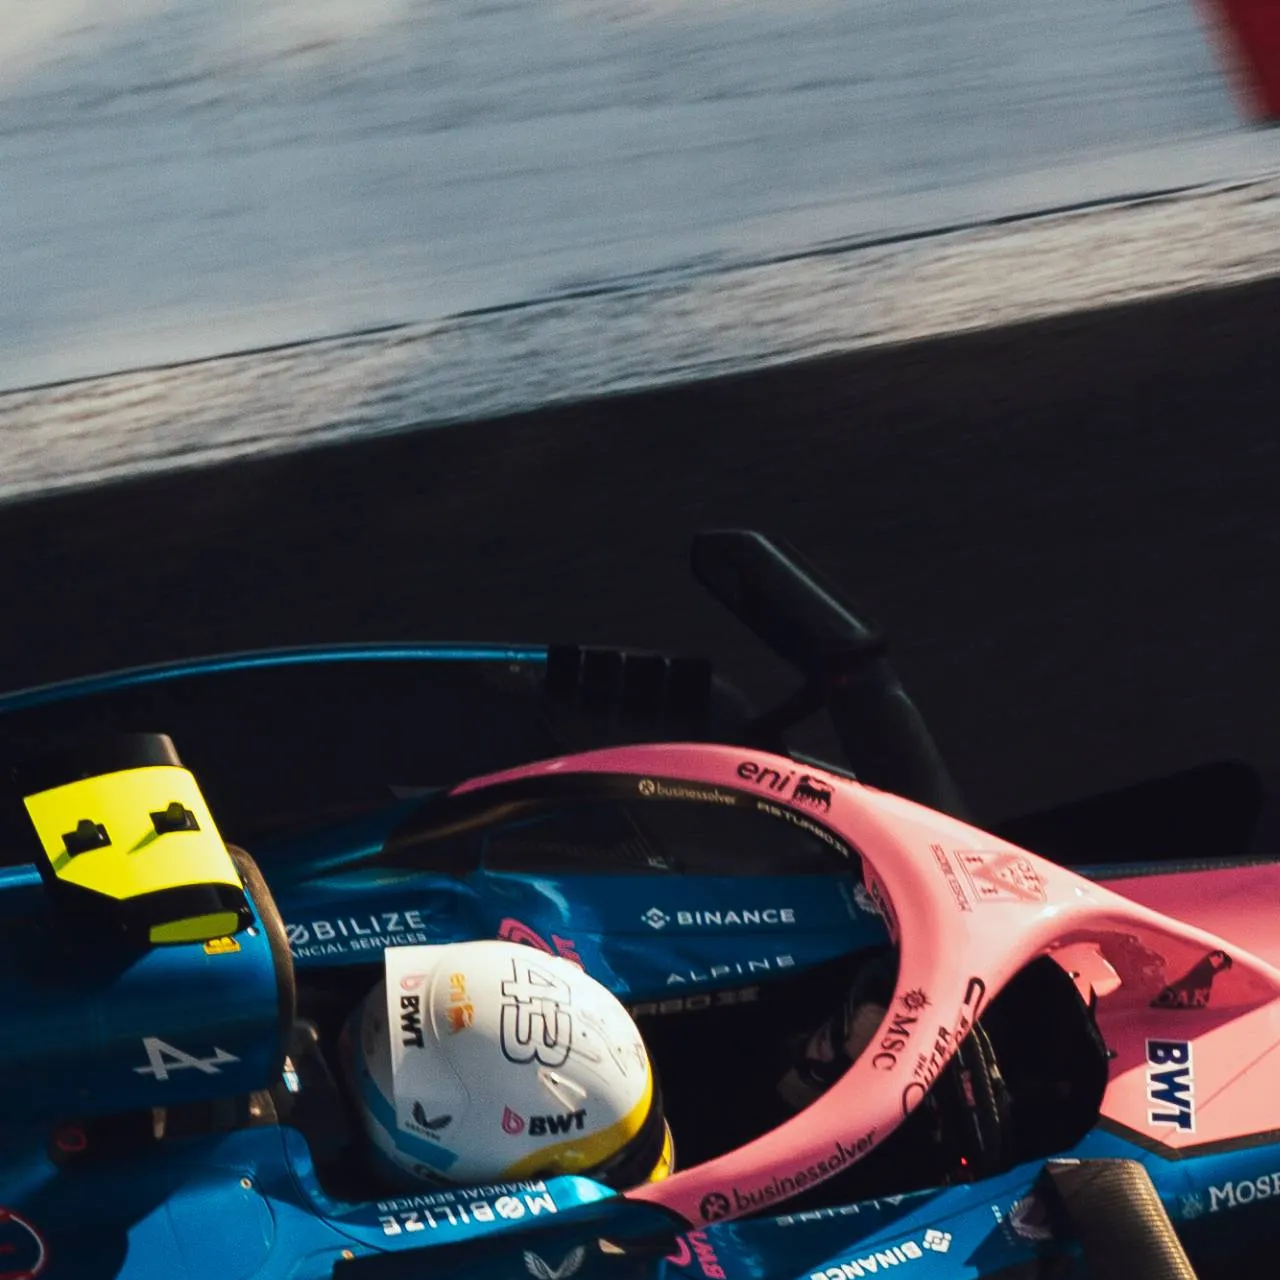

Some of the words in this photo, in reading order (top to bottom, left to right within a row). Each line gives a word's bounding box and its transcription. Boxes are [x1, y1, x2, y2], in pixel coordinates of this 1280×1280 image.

[736, 761, 796, 793] eni
[677, 907, 797, 928] BINANCE
[349, 931, 428, 952] SERVICES
[666, 954, 797, 986] ALPINE
[400, 995, 425, 1048] BWT
[872, 1013, 916, 1071] MSC
[1146, 1037, 1198, 1134] BWT
[529, 1109, 588, 1136] BWT
[733, 1127, 878, 1211] businessolver
